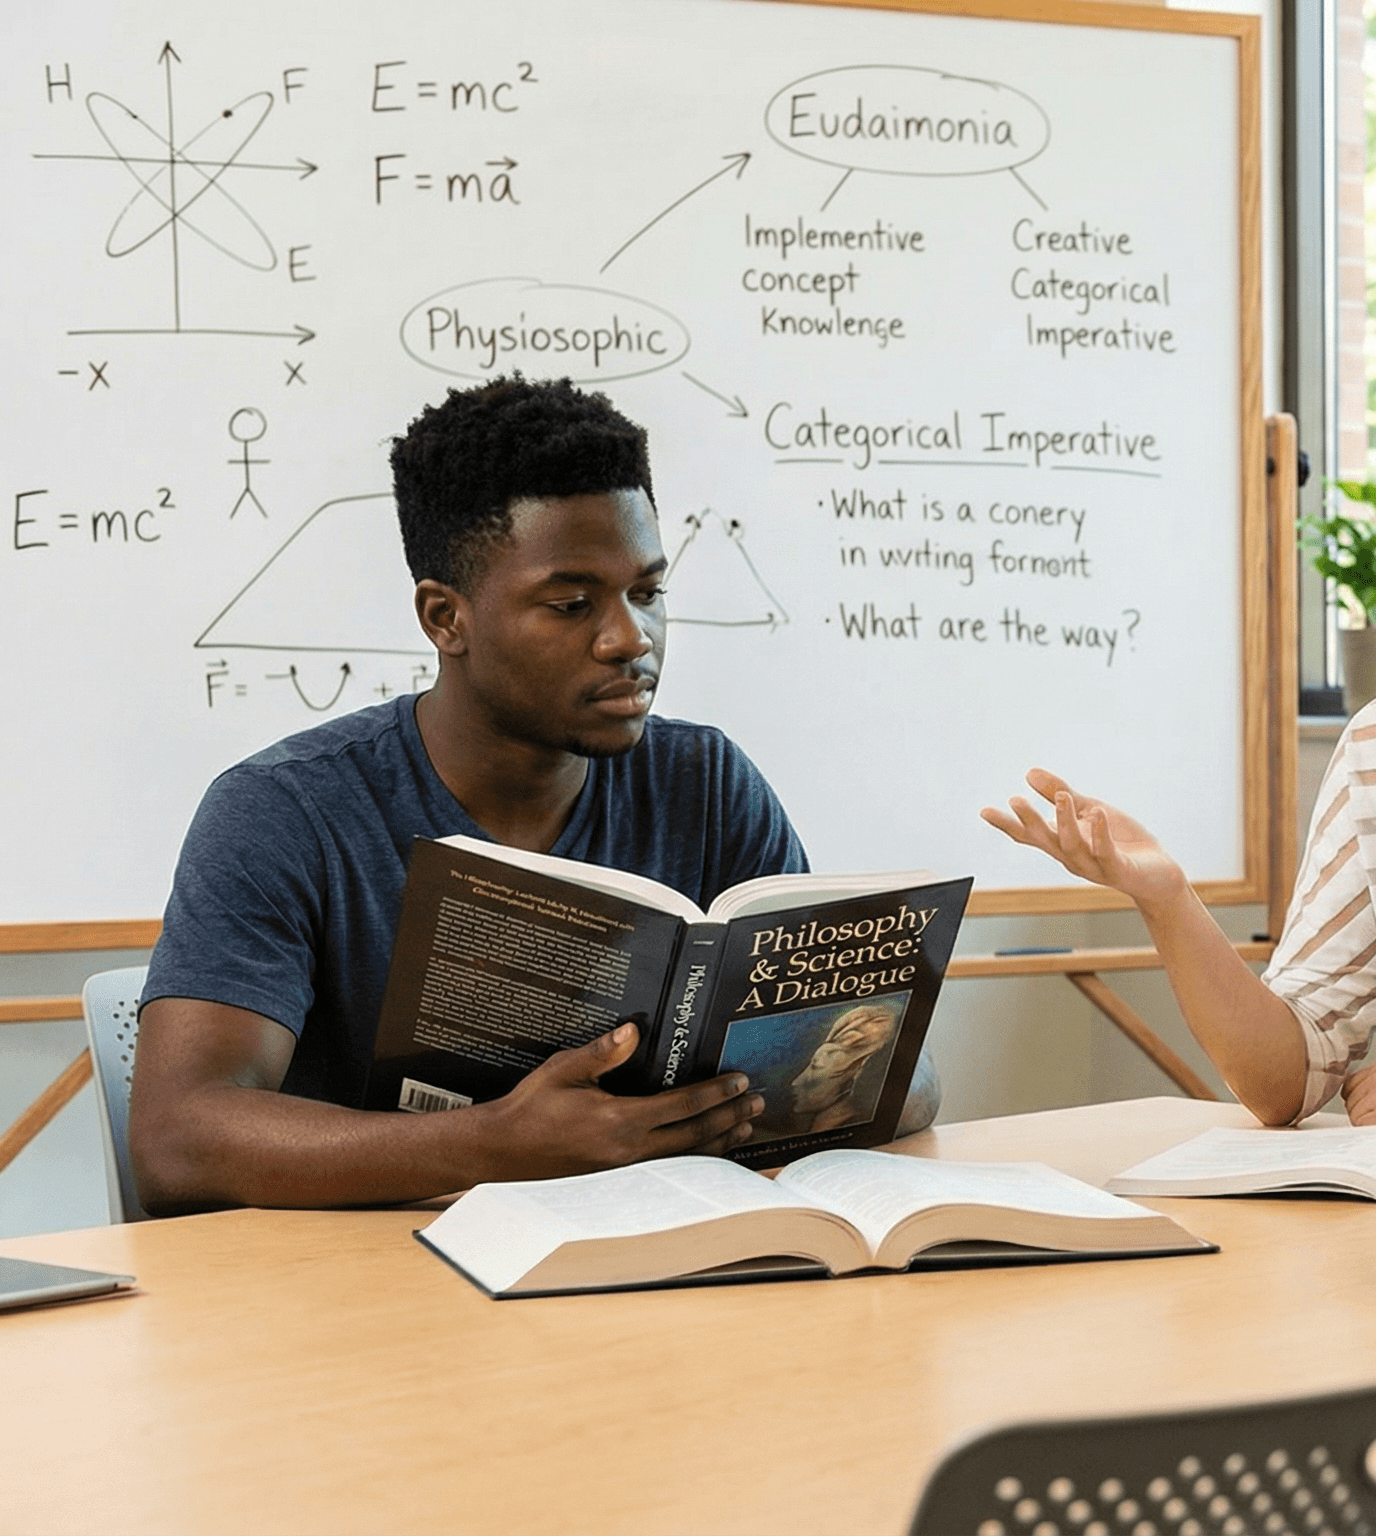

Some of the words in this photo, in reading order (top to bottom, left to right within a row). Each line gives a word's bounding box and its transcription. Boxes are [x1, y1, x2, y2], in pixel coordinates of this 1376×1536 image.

[45, 62, 73, 104] H
[282, 67, 308, 104] F
[789, 94, 1017, 148] Eudaimonia
[745, 213, 925, 259] Implementive
[1012, 217, 1133, 256] Creative
[288, 244, 316, 283] E
[742, 263, 860, 305] concept
[1011, 267, 1169, 314] Categorical
[427, 308, 668, 369] Physiosophic
[1027, 313, 1176, 358] Imperative
[764, 401, 963, 470] Categorical
[980, 411, 1162, 468] Imperative
[831, 488, 907, 520] What
[922, 493, 944, 522] is
[957, 502, 975, 522] a
[839, 538, 867, 567] in
[839, 602, 922, 640] What
[939, 617, 987, 642] are
[999, 606, 1050, 646] the
[1061, 609, 1141, 667] way?
[749, 904, 939, 957] Philosophy
[749, 958, 780, 984] &
[786, 936, 923, 977] Science:
[735, 986, 765, 1012] A
[773, 964, 916, 1006] Dialogue
